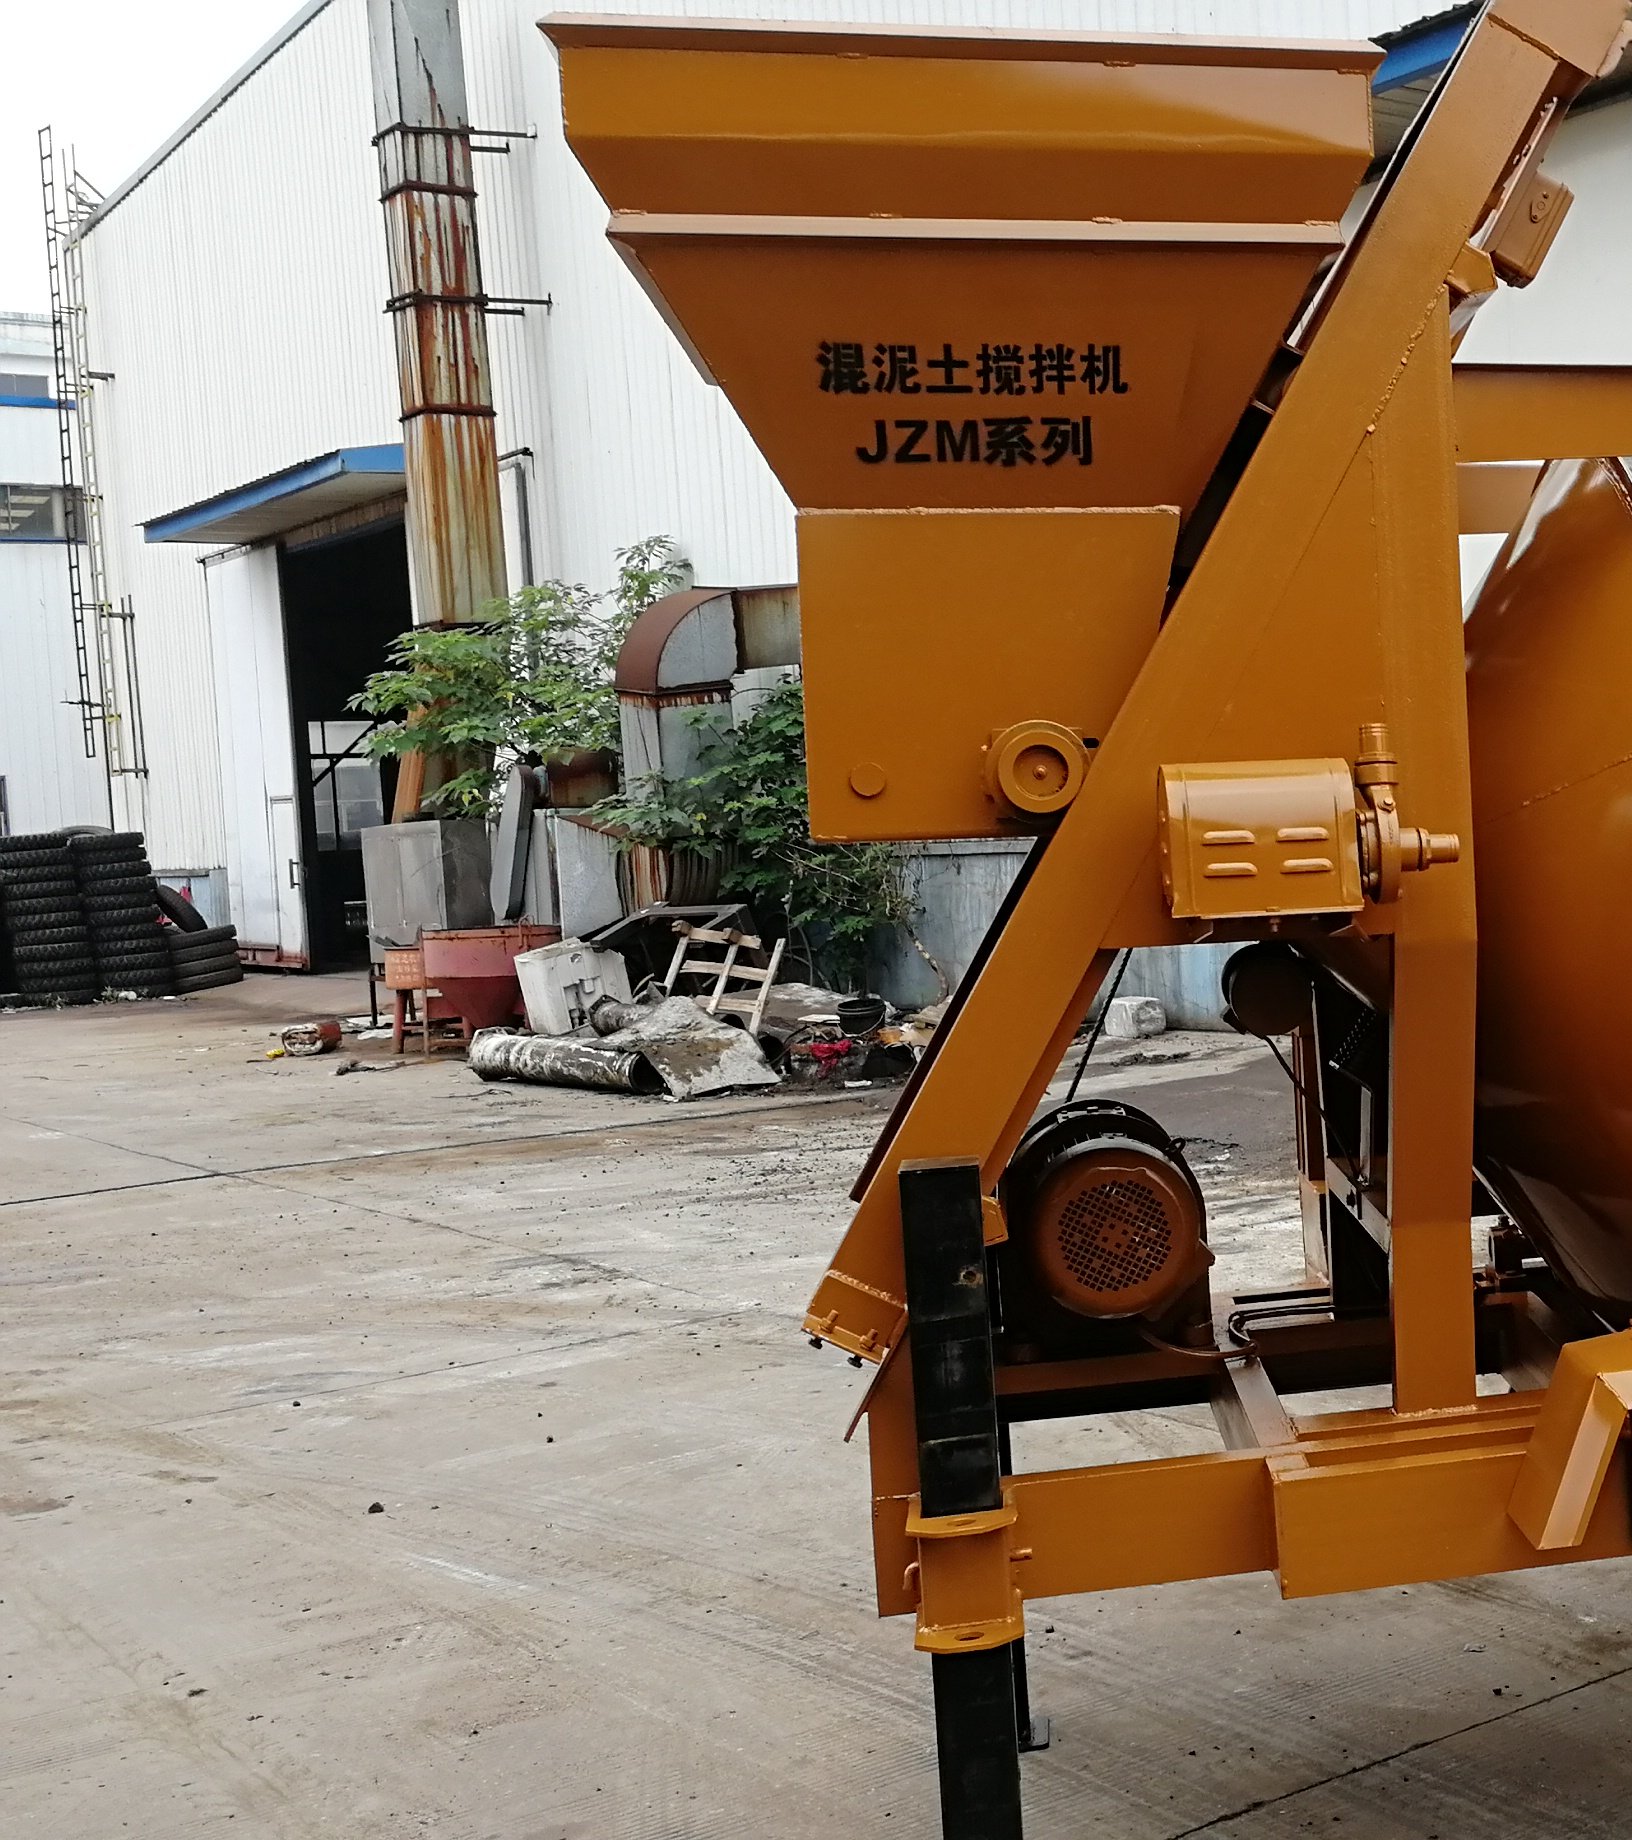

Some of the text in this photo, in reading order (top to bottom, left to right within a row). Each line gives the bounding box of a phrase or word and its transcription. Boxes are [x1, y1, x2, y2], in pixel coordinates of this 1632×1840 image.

[818, 341, 1129, 395] 混泥土搅拌机
[855, 416, 1094, 468] JZM系列
